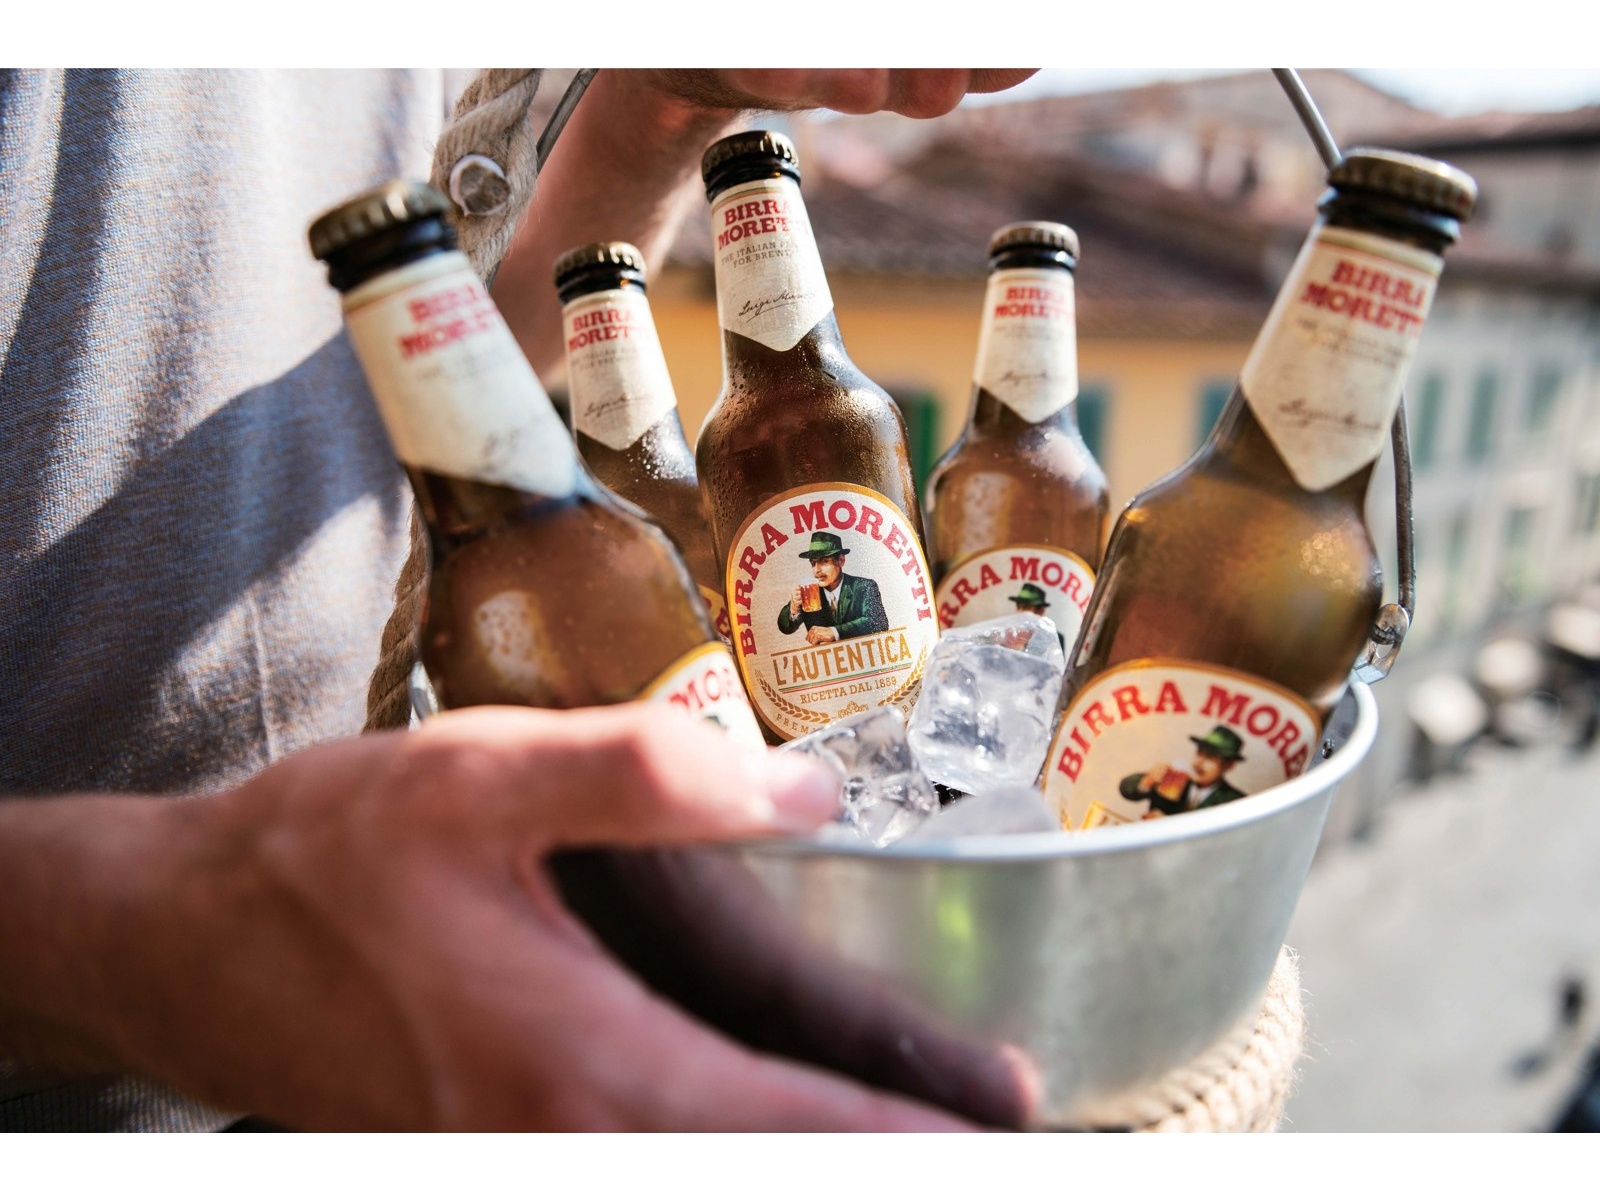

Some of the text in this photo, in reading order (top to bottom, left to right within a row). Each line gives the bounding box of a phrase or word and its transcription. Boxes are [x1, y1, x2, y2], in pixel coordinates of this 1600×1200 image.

[718, 217, 802, 251] MORET
[736, 241, 777, 259] ITALIAN
[733, 254, 753, 269] FOR
[735, 499, 932, 658] BIRRA MORETTI
[772, 633, 913, 686] L'AUTENTICA
[799, 675, 898, 705] RICETTA DAL 1859
[776, 713, 817, 734] PREM
[1057, 680, 1189, 784] BIRRA
